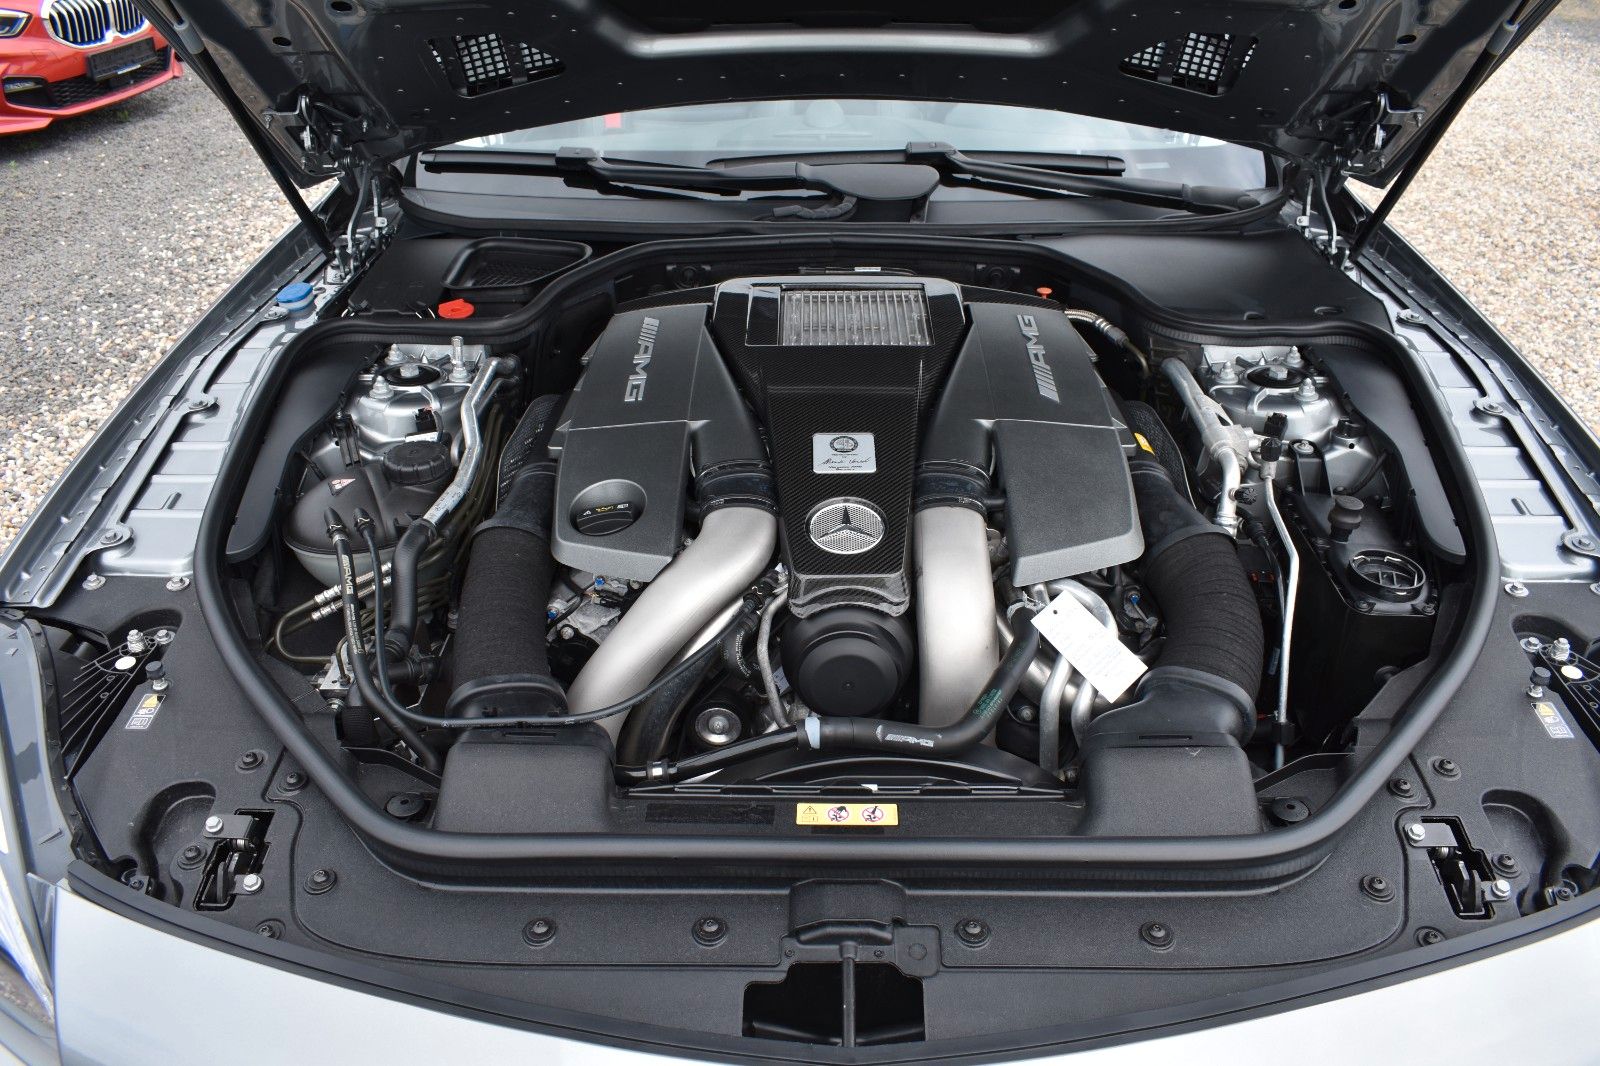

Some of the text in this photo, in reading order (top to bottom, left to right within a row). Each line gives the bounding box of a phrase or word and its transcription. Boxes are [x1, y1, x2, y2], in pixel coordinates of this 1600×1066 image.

[624, 340, 655, 402] AMG
[1017, 314, 1051, 372] AMG
[344, 565, 354, 595] AMG
